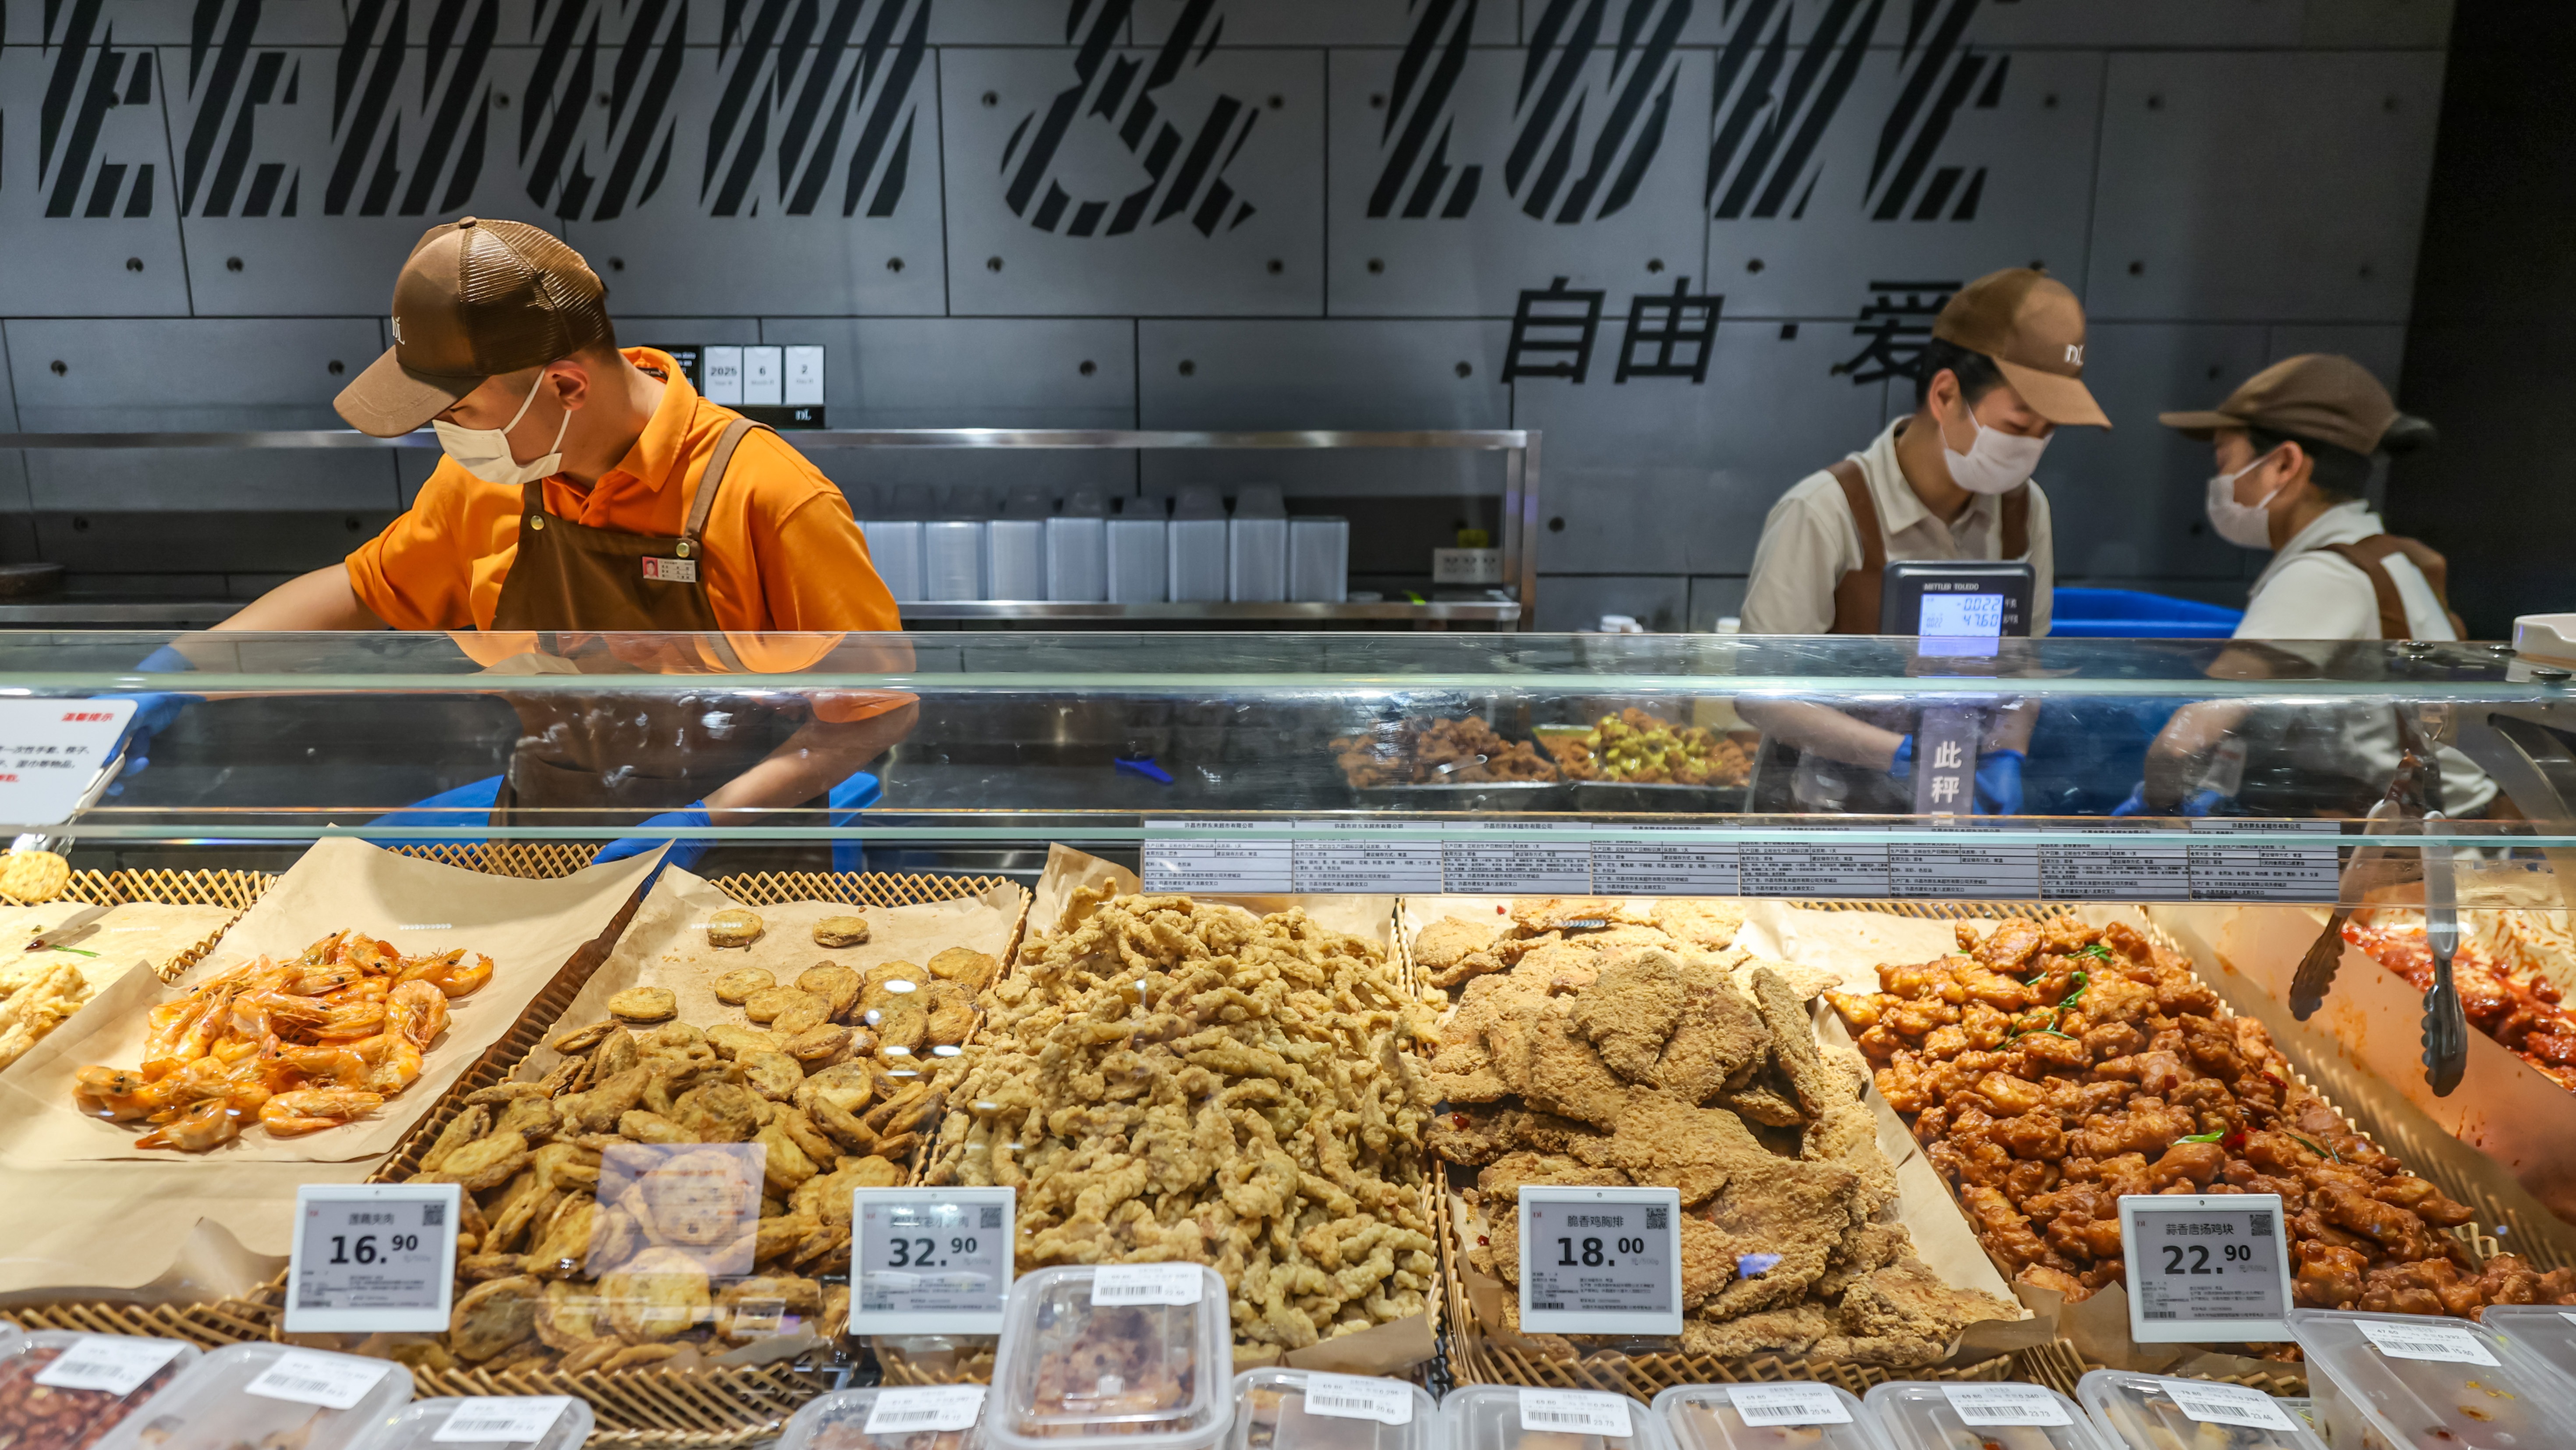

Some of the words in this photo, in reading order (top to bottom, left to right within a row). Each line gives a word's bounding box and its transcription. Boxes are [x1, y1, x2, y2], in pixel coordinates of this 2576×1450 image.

[711, 367, 737, 376] 2025
[759, 367, 765, 376] 6
[801, 364, 808, 375] 2
[61, 713, 115, 722] 温馨提示
[1568, 1216, 1623, 1227] 脆香鸡胸排
[2166, 1224, 2234, 1235] 蒜香唐扬鸡块
